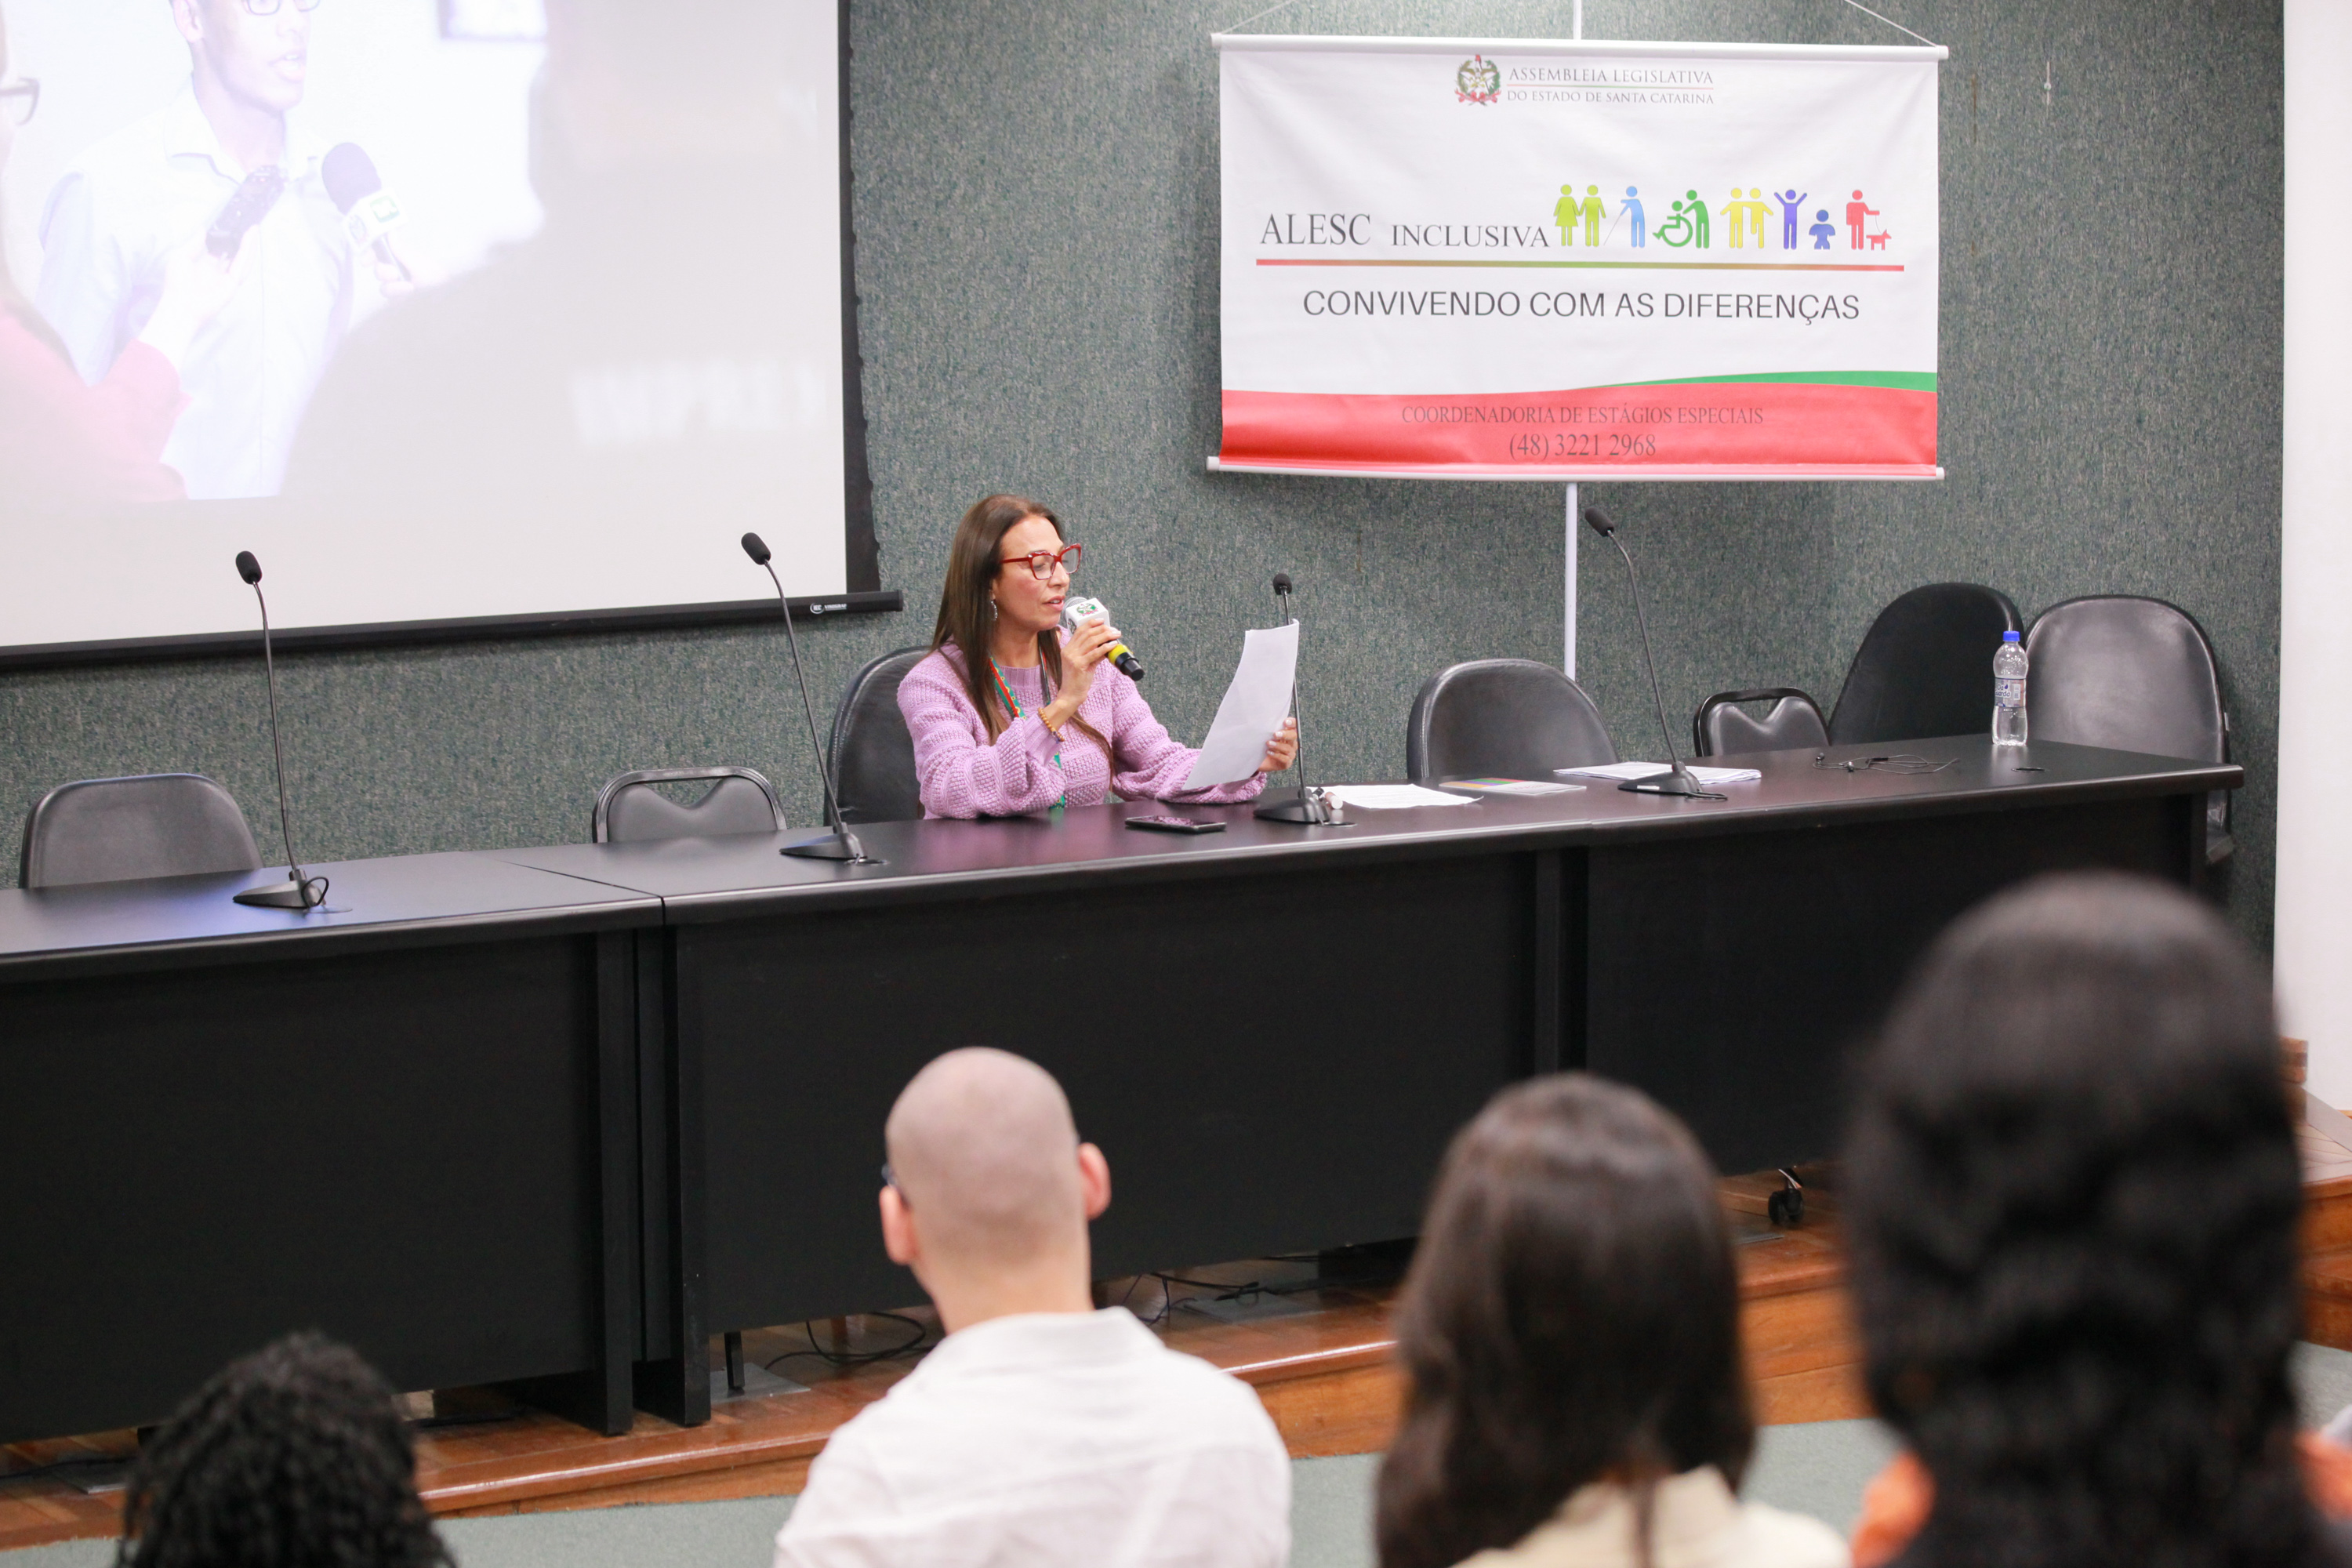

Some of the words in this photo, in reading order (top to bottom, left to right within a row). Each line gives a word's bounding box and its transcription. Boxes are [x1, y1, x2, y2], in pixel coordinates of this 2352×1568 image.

[1509, 67, 1607, 82] ASSEMBLEIA
[1613, 69, 1714, 84] LEGISLATIVA
[1507, 90, 1528, 101] DO
[1532, 91, 1581, 102] ESTADO
[1585, 92, 1602, 103] DE
[1606, 92, 1648, 103] SANTA
[1650, 93, 1715, 104] CATARINA
[1260, 212, 1371, 246] ALESC
[1392, 224, 1550, 248] INCLUSIVA
[1303, 289, 1521, 317] CONVIVENDO
[1530, 291, 1606, 317] COM
[1614, 292, 1654, 318] AS
[1664, 292, 1860, 325] DIFERENÇAS
[1402, 406, 1555, 423] COORDENADORIA
[1559, 407, 1584, 423] DE
[1588, 402, 1673, 424] ESTÁGIOS
[1678, 407, 1764, 424] ESPECIAIS
[1509, 434, 1550, 461] (48)
[1554, 434, 1599, 456] 3221
[1608, 434, 1657, 456] 2968
